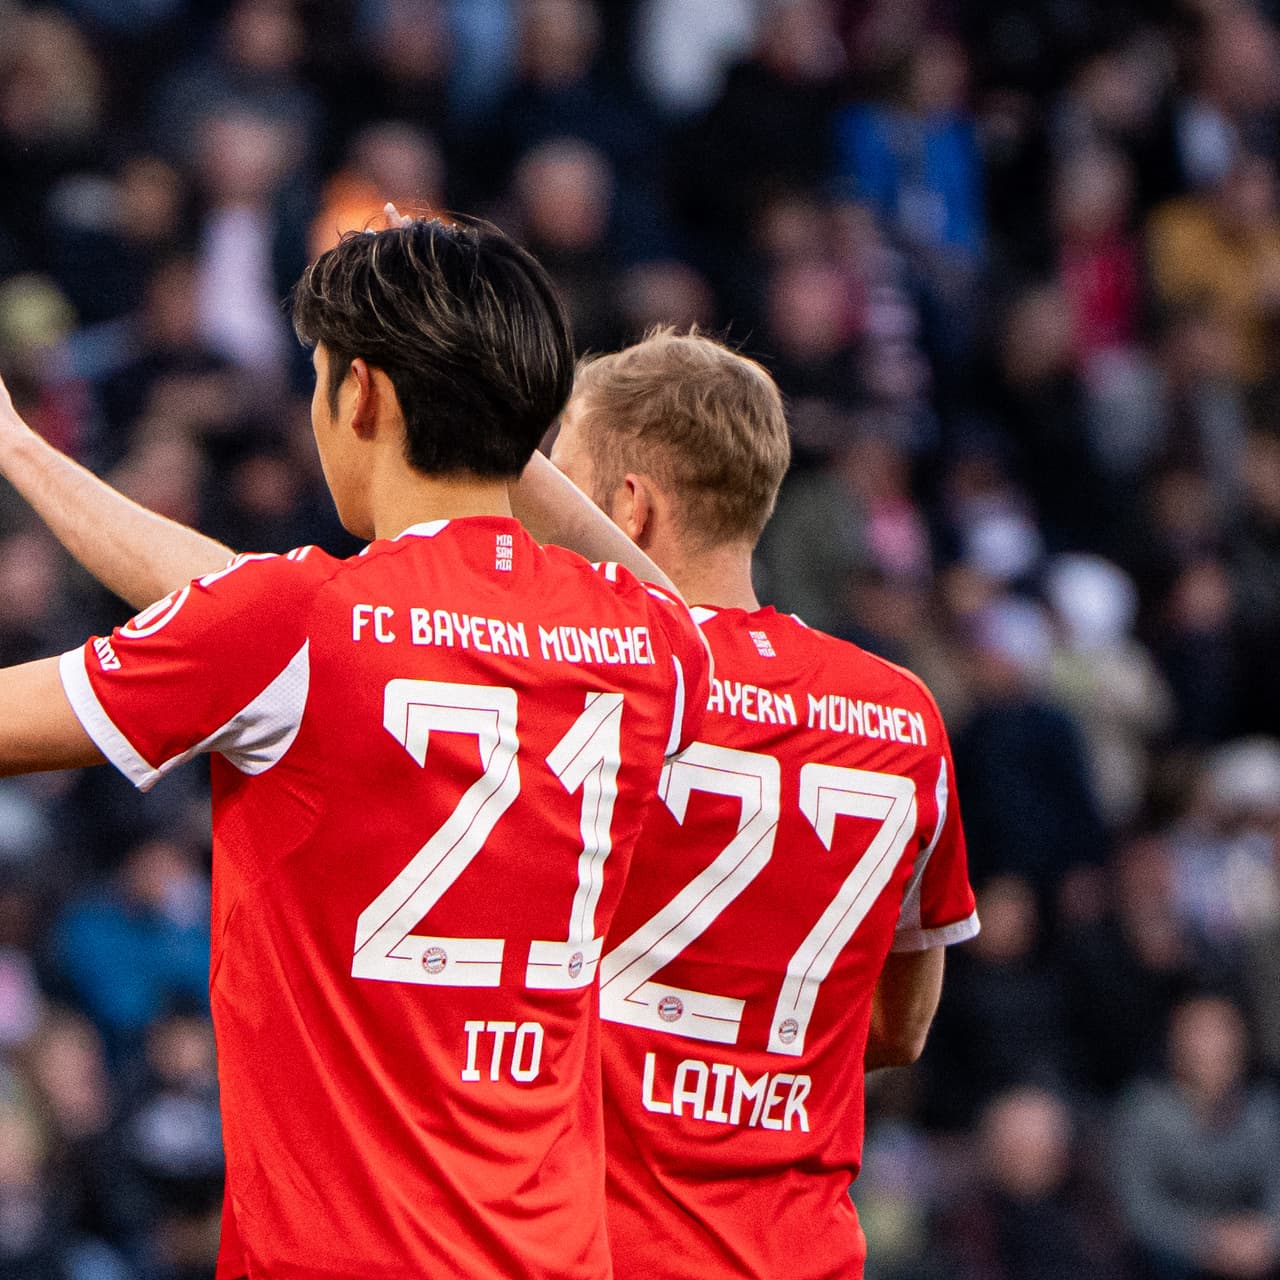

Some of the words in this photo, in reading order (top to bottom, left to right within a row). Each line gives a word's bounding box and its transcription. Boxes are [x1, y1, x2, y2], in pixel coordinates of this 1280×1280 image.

[352, 603, 396, 643] FC
[410, 607, 530, 658] BAYERN
[706, 678, 798, 726] AYERN
[807, 692, 928, 747] MÜNCHEN
[351, 678, 625, 990] 21
[600, 741, 917, 1057] 27
[460, 1020, 545, 1083] ITO
[641, 1051, 812, 1133] LAIMER
